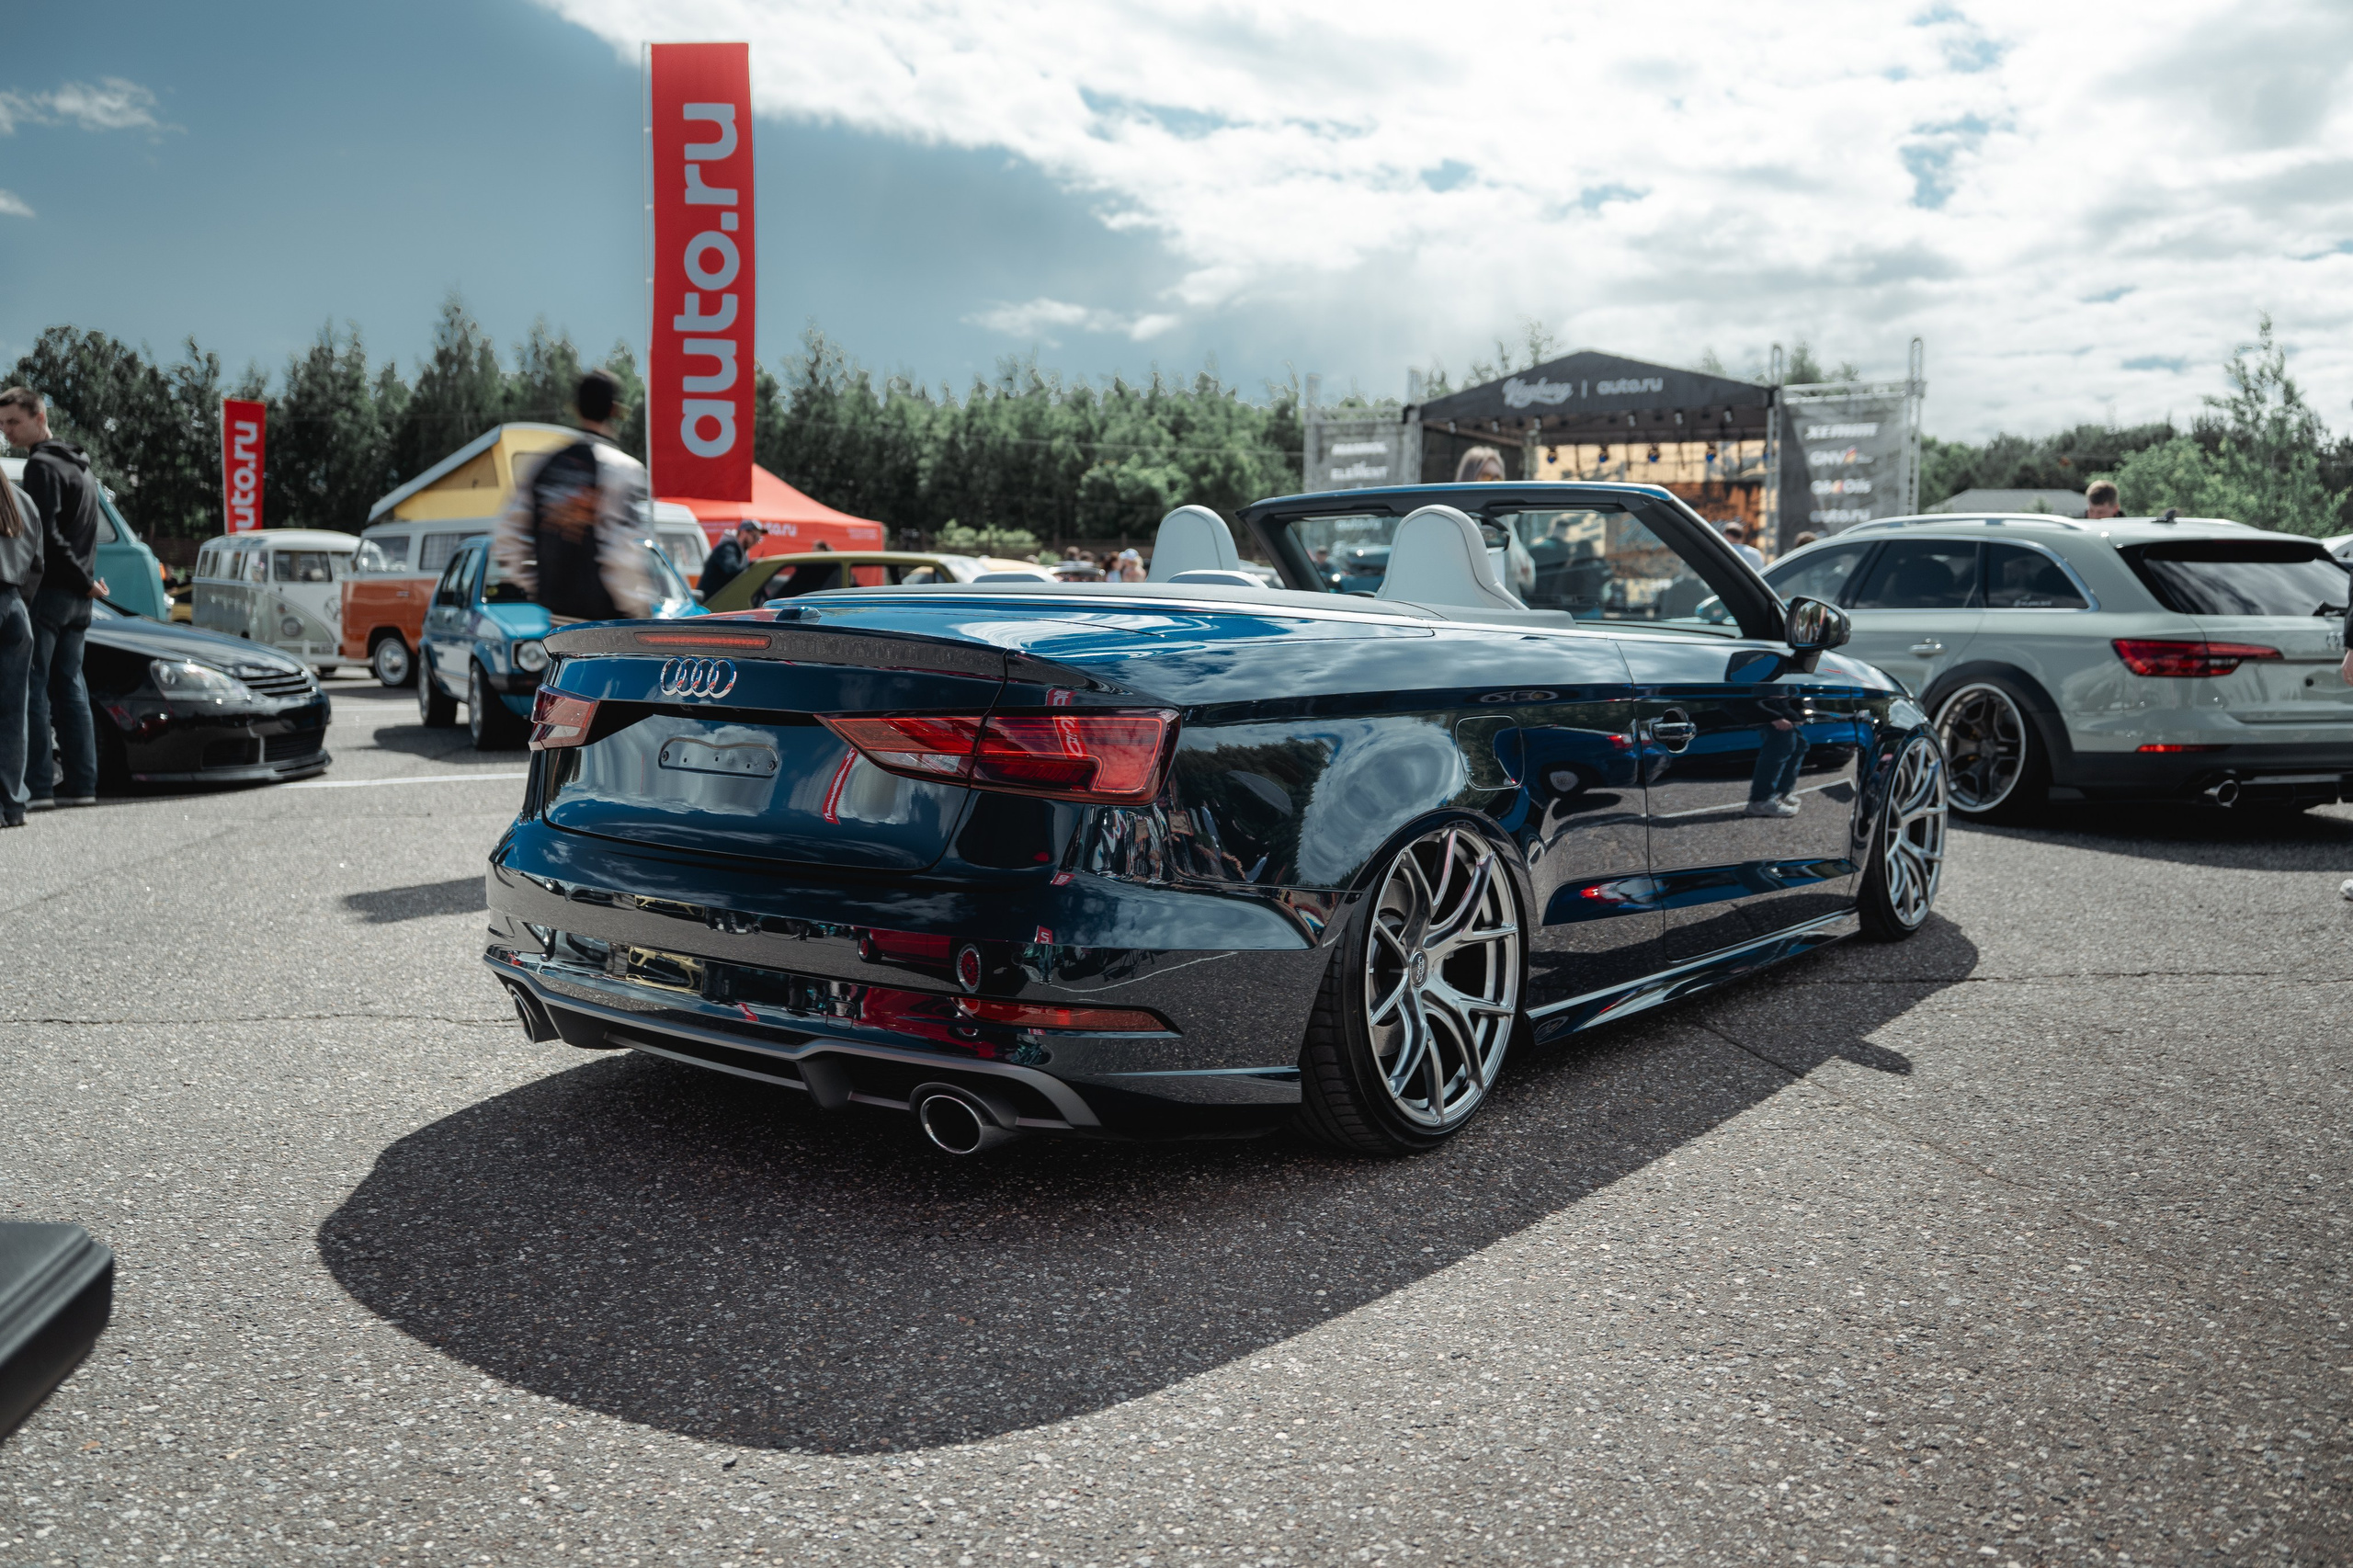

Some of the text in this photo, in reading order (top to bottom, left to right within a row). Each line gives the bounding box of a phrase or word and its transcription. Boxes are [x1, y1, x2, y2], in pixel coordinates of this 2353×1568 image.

[673, 102, 740, 459] auto.ru
[1597, 377, 1664, 395] auto.ru
[231, 420, 257, 535] uto.ru
[1808, 508, 1871, 524] auto.ru
